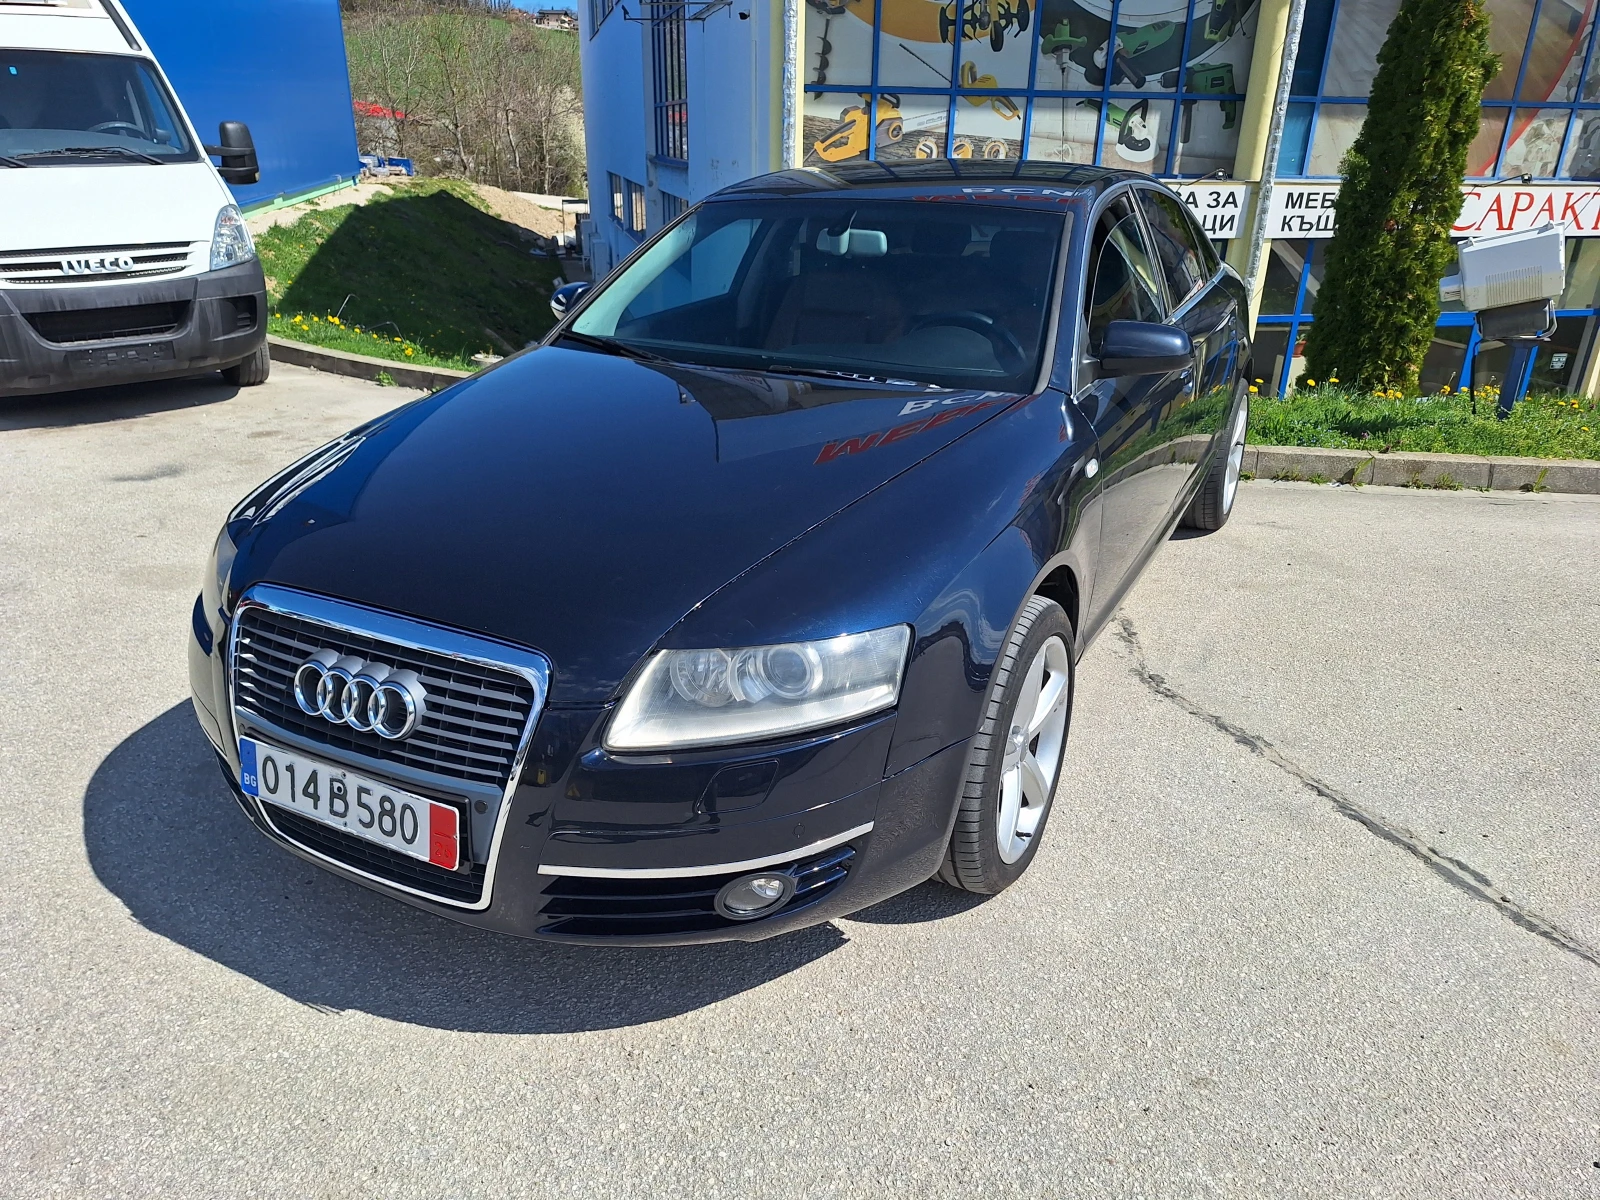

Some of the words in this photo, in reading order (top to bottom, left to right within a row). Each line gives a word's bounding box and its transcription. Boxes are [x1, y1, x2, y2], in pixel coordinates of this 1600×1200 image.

[1176, 191, 1199, 208] А
[1206, 191, 1238, 208] ЗА
[1285, 192, 1336, 209] МЕБ
[61, 256, 134, 274] IVECO
[244, 772, 257, 788] BG
[262, 756, 419, 845] 014B580
